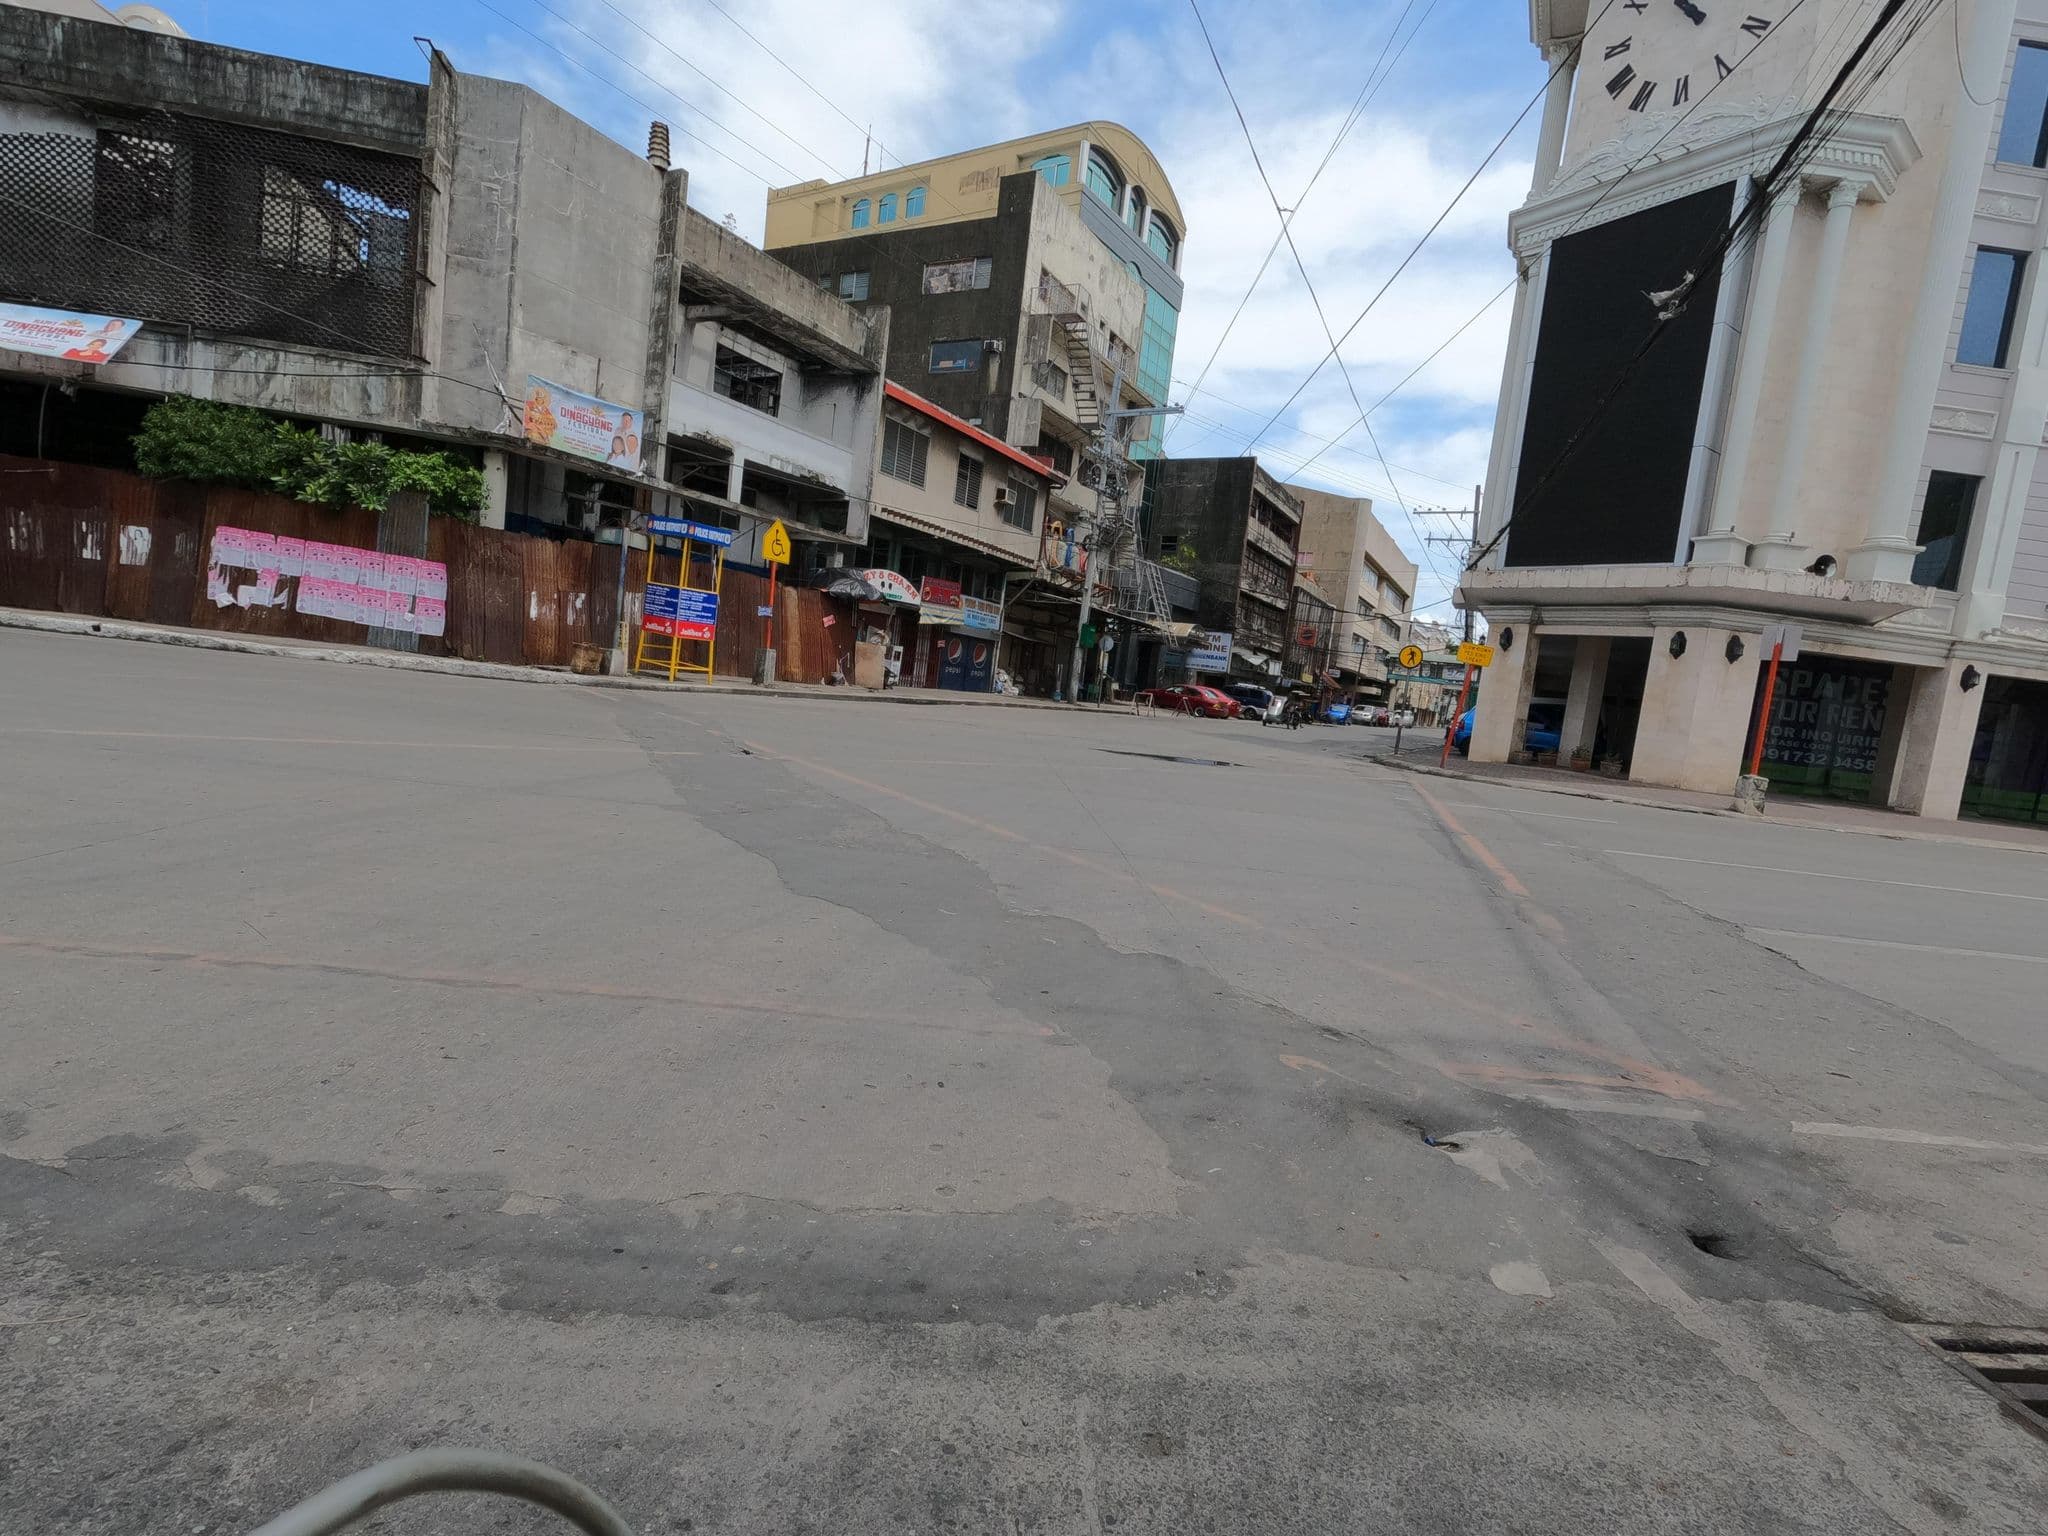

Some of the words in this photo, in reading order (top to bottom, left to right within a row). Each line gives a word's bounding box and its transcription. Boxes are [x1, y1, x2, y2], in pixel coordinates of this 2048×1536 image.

[560, 407, 613, 432] DINAGYANG
[653, 520, 666, 531] POLICE
[695, 526, 709, 538] POLICE
[1768, 726, 1795, 738] OR
